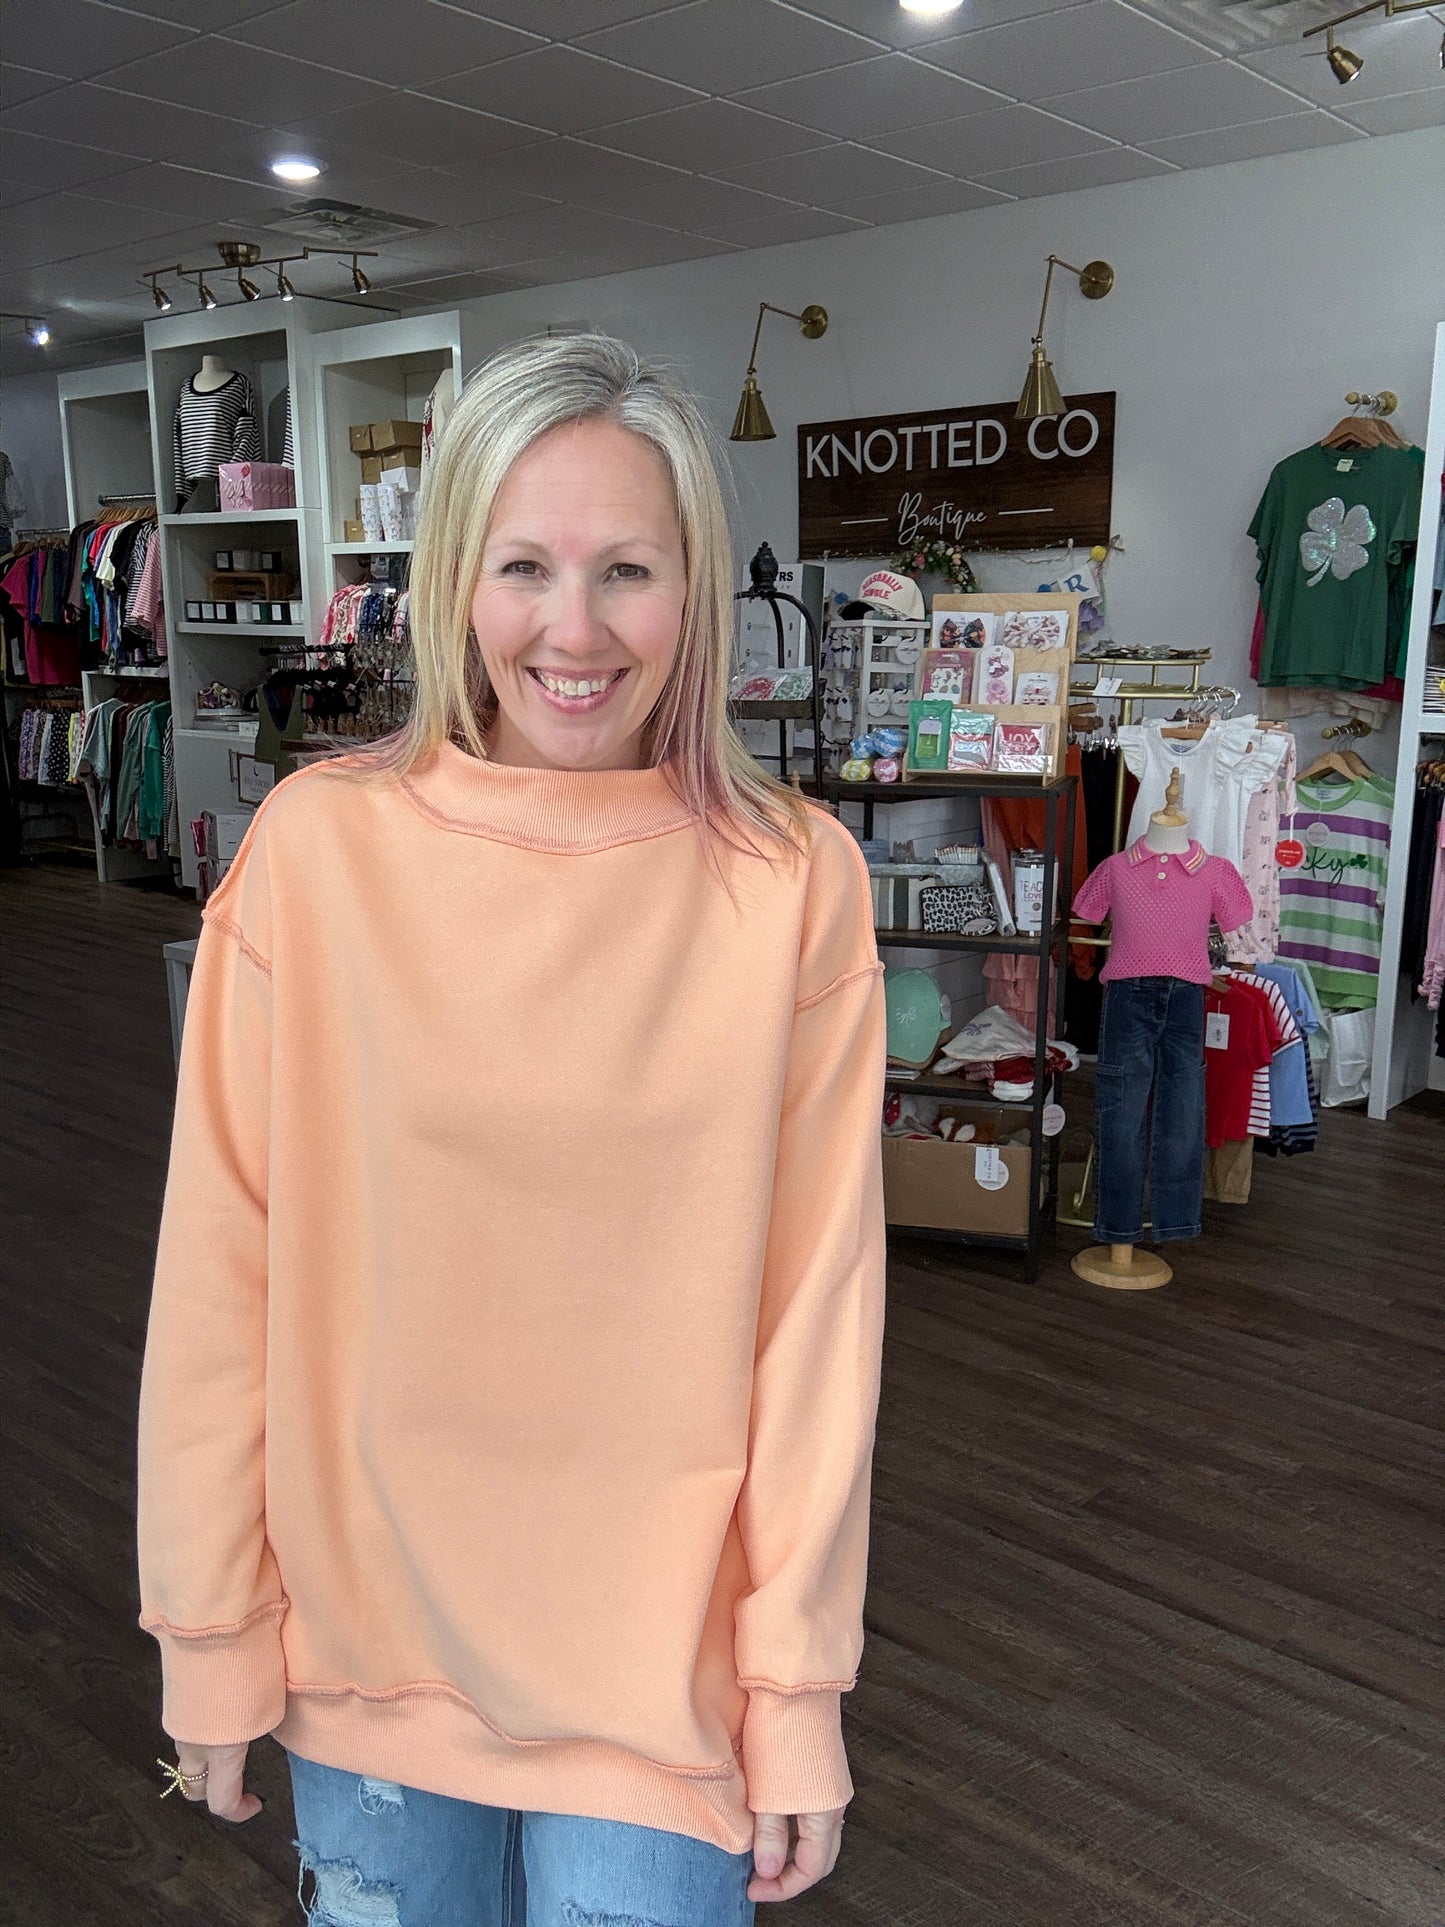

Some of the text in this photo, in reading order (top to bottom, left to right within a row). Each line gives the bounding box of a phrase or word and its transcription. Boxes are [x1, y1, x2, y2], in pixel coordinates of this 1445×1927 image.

[806, 409, 1099, 479] KNOTTED CO
[898, 492, 987, 545] Boutique
[1063, 573, 1089, 592] R
